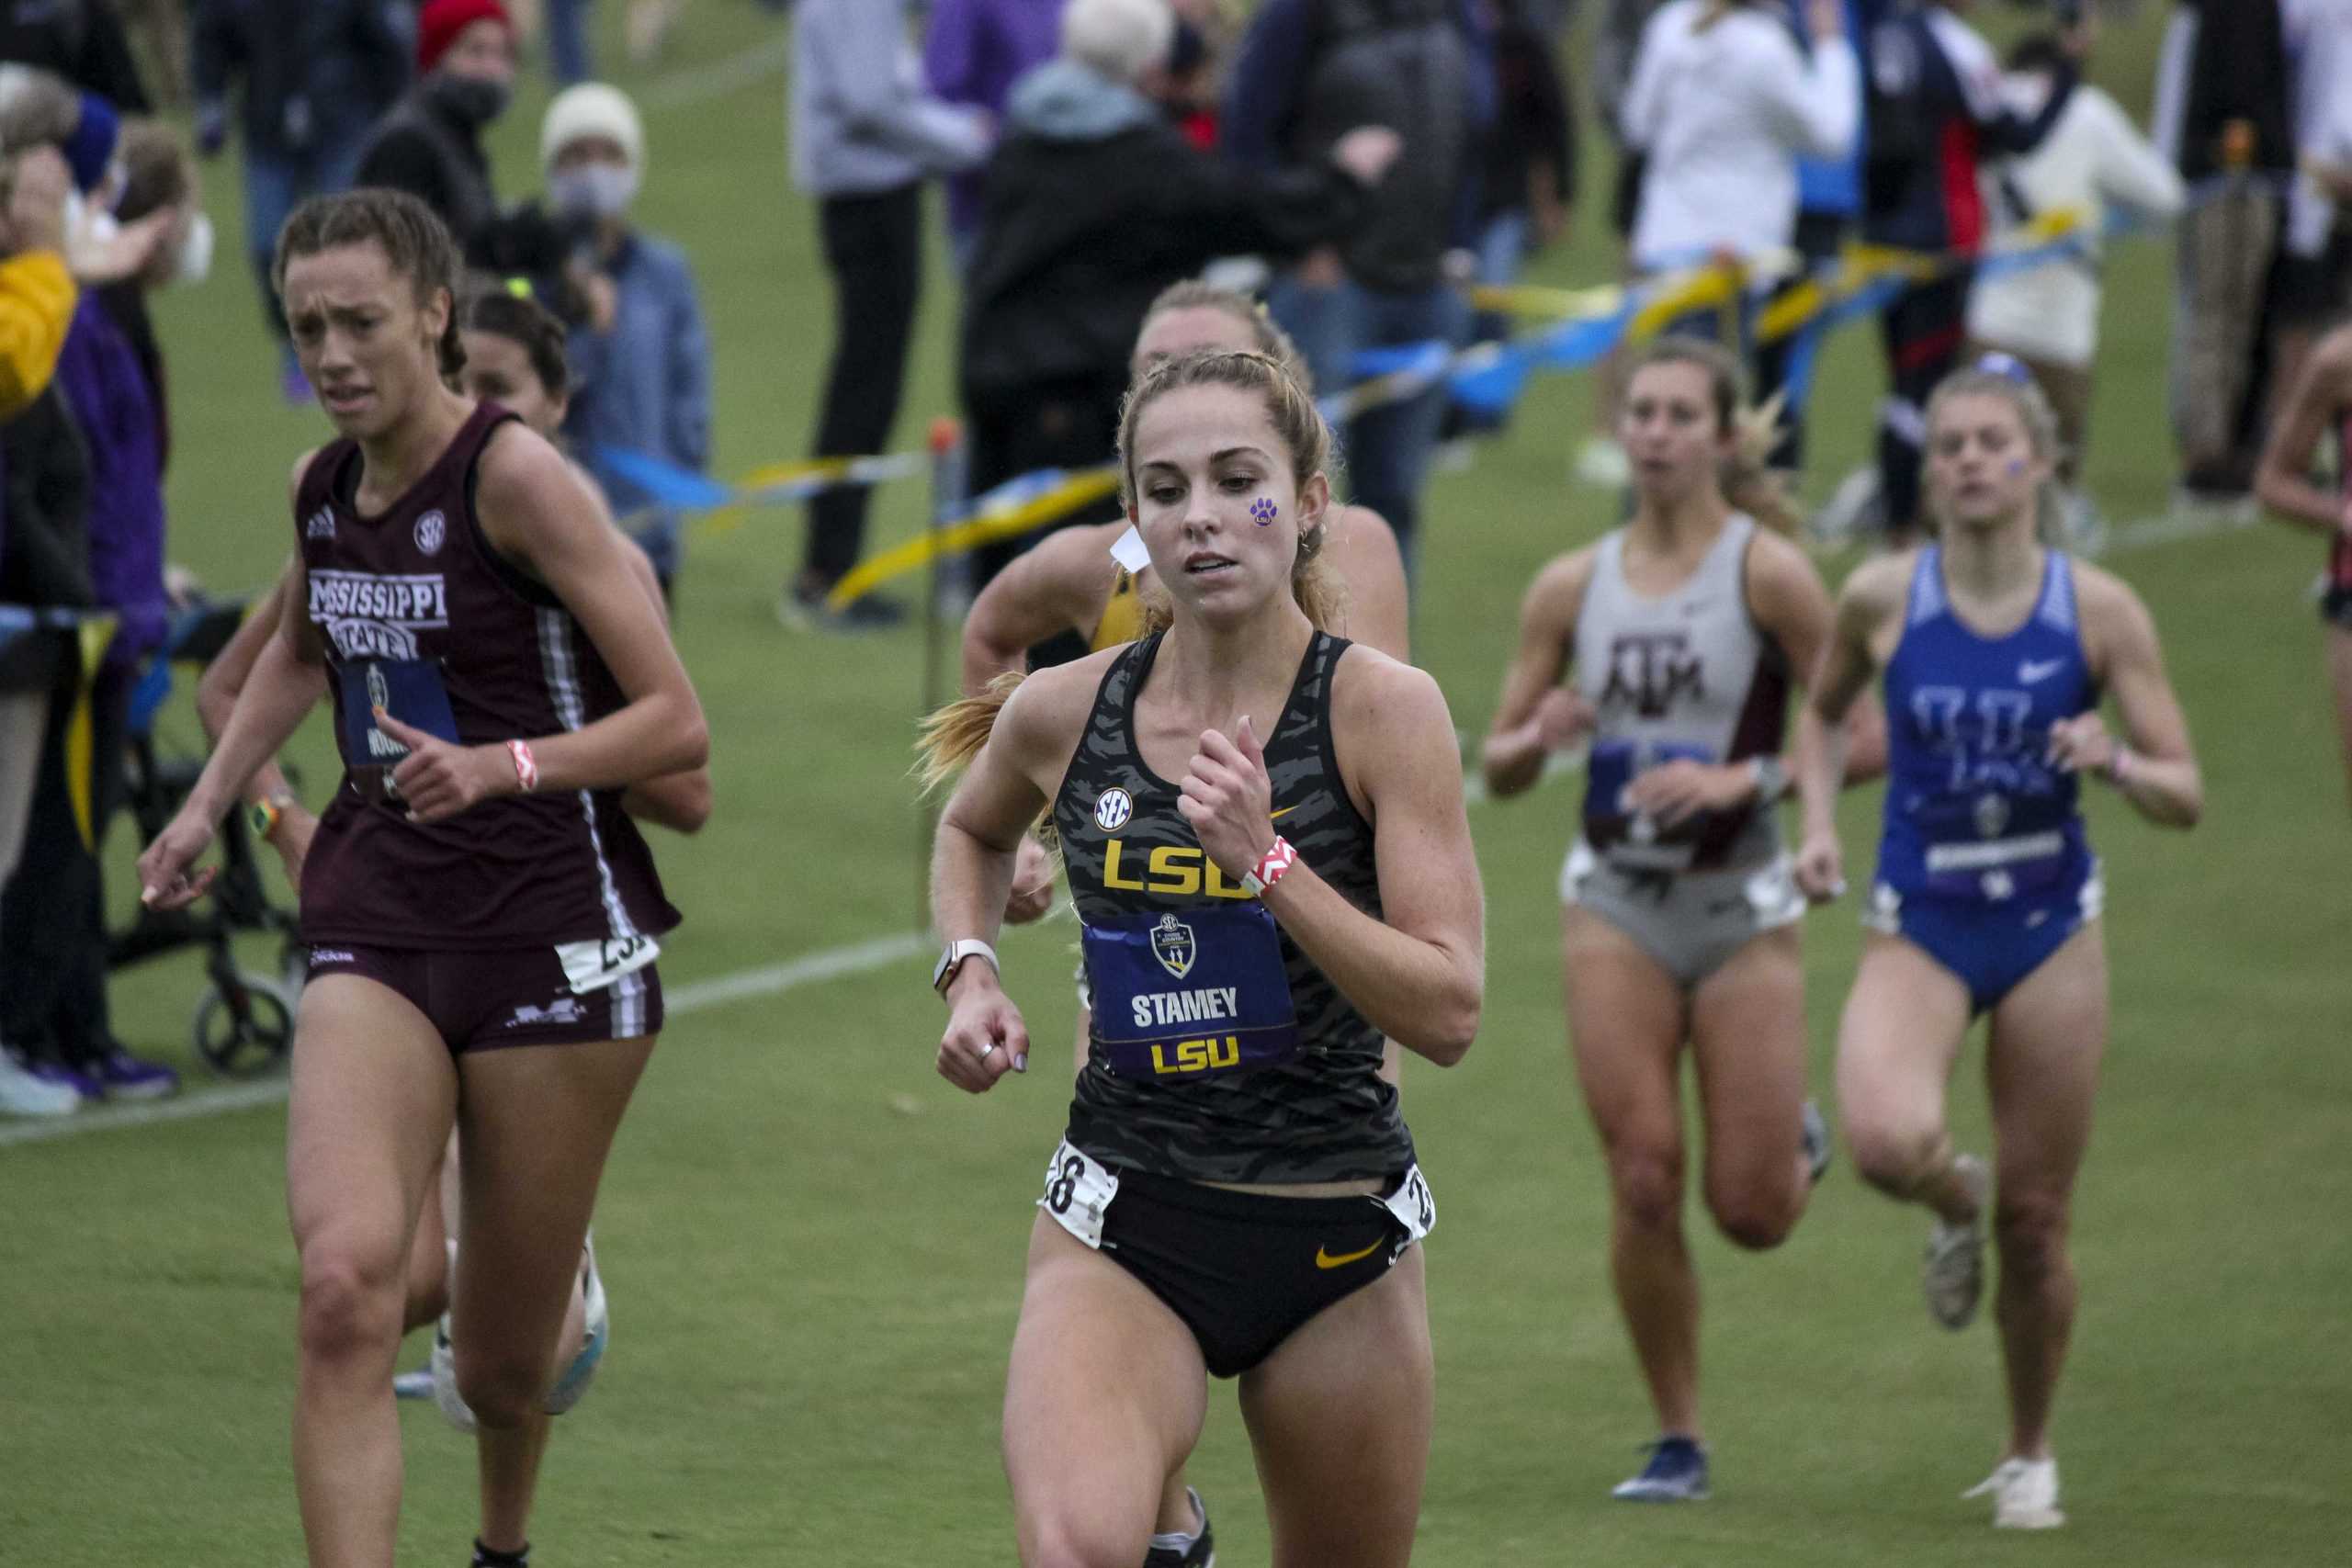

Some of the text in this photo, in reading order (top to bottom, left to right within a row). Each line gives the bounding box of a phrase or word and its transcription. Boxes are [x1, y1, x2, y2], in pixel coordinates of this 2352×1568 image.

[1095, 789, 1131, 828] SEC
[1131, 987, 1238, 1028] STAMEY
[1150, 1036, 1239, 1074] LSU
